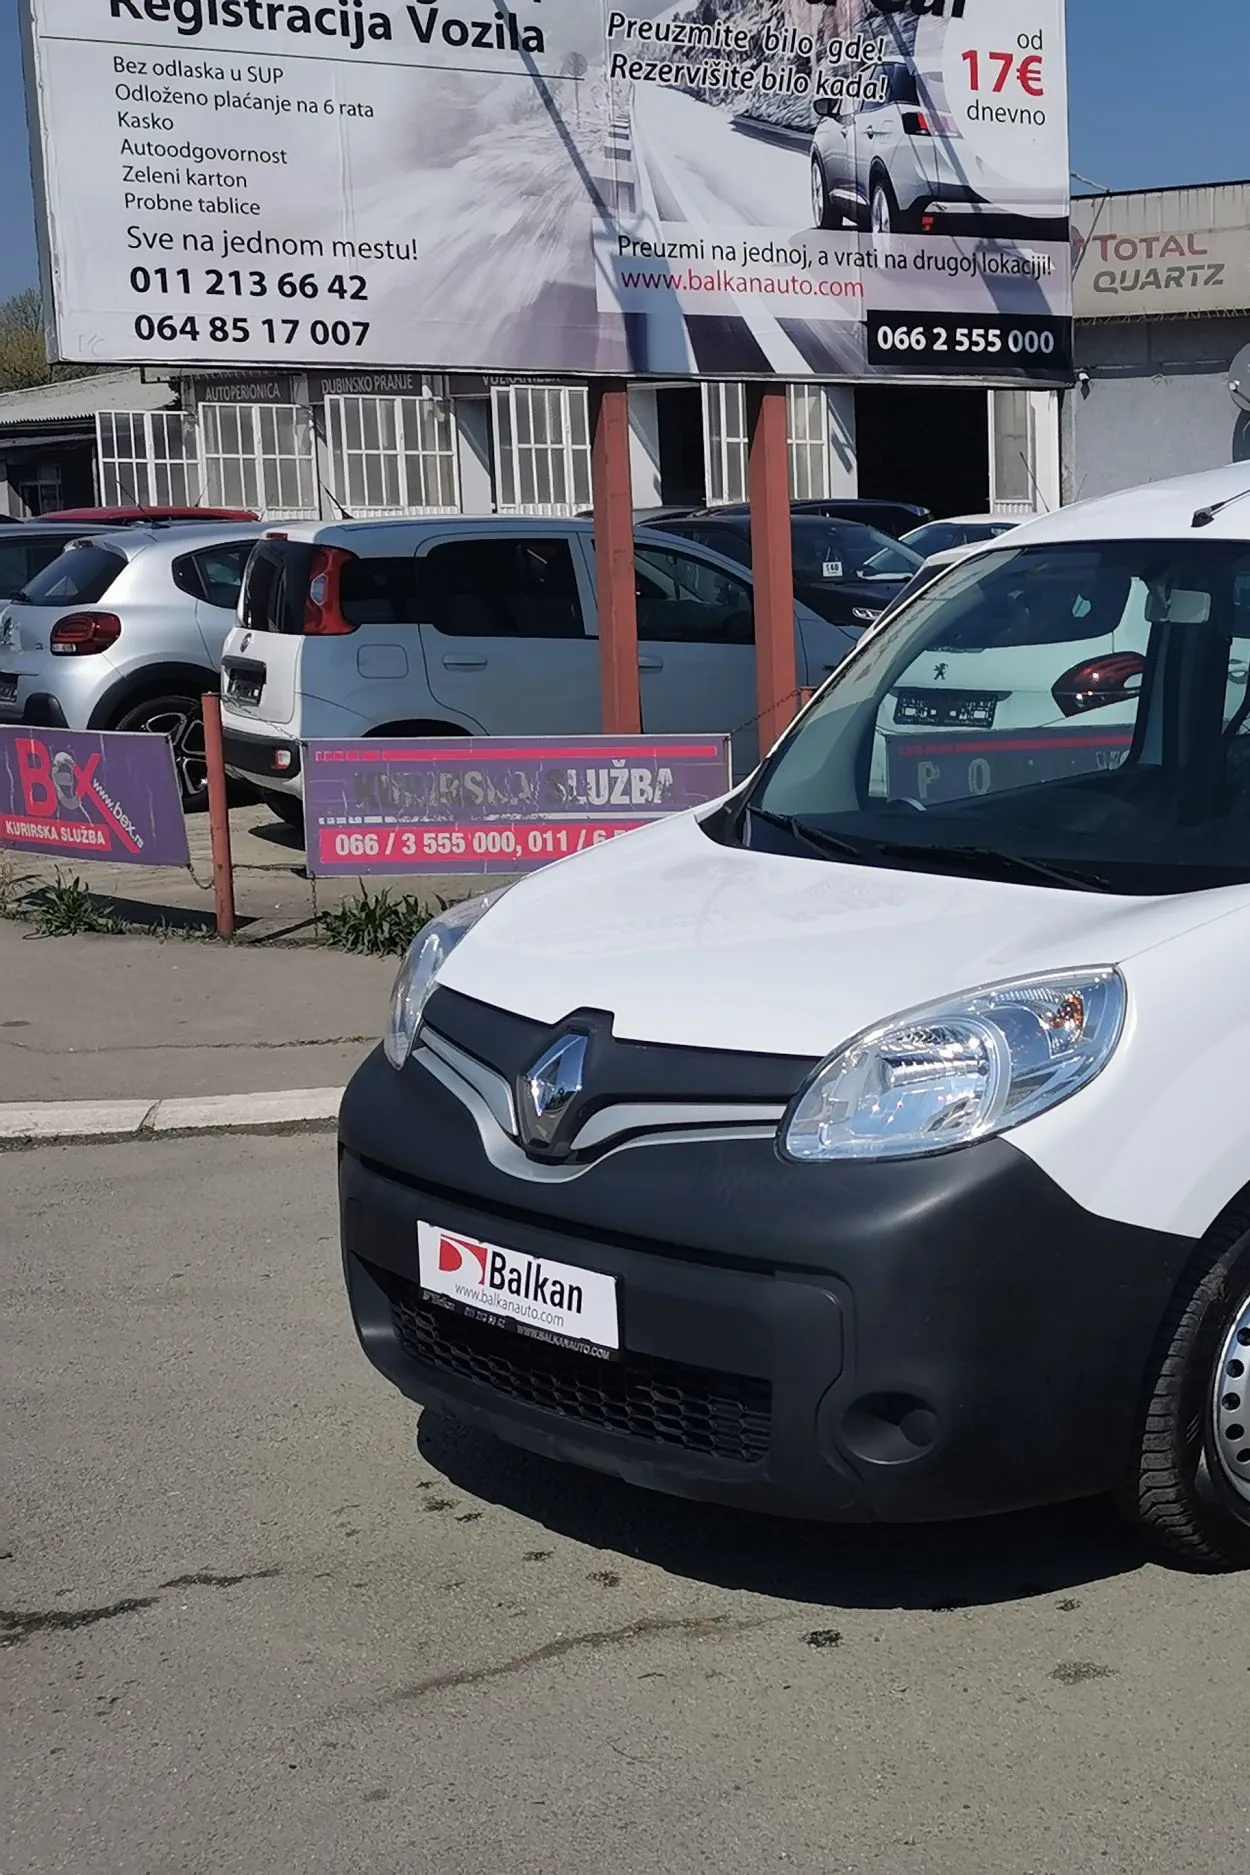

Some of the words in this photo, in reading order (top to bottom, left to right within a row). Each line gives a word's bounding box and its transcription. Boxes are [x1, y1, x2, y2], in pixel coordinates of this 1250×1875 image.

[407, 6, 545, 53] Vozila
[607, 12, 749, 49] Preuzmite
[765, 26, 813, 54] bilo
[829, 35, 885, 64] gde!
[1017, 30, 1043, 50] od
[113, 56, 147, 75] Bez
[153, 60, 225, 80] odlaska
[230, 69, 242, 82] u
[247, 66, 284, 84] SUP
[610, 53, 754, 90] Rezervišite
[761, 65, 809, 93] bilo
[815, 72, 887, 100] kada!
[961, 50, 1044, 97] 17€
[115, 84, 208, 106] Odloženo
[214, 91, 291, 115] plaćanje
[297, 101, 319, 114] na
[323, 100, 335, 115] 6
[339, 102, 374, 118] rata
[967, 99, 1046, 126] dnevno
[118, 111, 174, 131] Kasko
[120, 139, 288, 164] Autoodgovornost
[122, 165, 180, 185] Zeleni
[187, 168, 248, 188] karton
[124, 192, 193, 213] Probne
[198, 196, 261, 215] tablice
[127, 225, 174, 250] Sve
[183, 233, 214, 252] na
[221, 230, 323, 258] jednom
[333, 239, 418, 261] mestu!
[1091, 232, 1208, 262] TOTAL
[618, 235, 704, 260] Preuzmi
[712, 244, 736, 262] na
[741, 240, 813, 270] jednoj,
[818, 250, 829, 266] a
[834, 249, 878, 268] vrati
[885, 252, 907, 270] na
[913, 249, 977, 277] drugoj
[982, 252, 1052, 281] lokaciji!
[130, 266, 191, 294] 011
[205, 269, 267, 297] 213
[278, 272, 319, 299] 66
[328, 274, 369, 301] 42
[621, 268, 864, 297] www.balkanauto.com
[1093, 263, 1225, 295] QUARTZ
[134, 314, 200, 342] 064
[209, 317, 250, 343] 85
[261, 318, 300, 344] 17
[310, 320, 370, 346] 007
[877, 325, 927, 351] 066
[932, 326, 948, 351] 2
[955, 328, 1002, 352] 555
[1008, 329, 1055, 354] 000
[205, 383, 281, 401] AUTOPERIONICA
[321, 376, 373, 394] DUBINSKO
[373, 374, 414, 391] PRANJE
[5, 820, 59, 841] KURIRSKA
[61, 826, 106, 845] SLUŽBA
[335, 833, 378, 856] 066
[385, 832, 396, 856] /
[401, 832, 417, 856] 3
[423, 831, 466, 855] 555
[472, 830, 523, 857] 000,
[527, 830, 568, 852] 011
[489, 1250, 583, 1315] Balkan
[454, 1282, 565, 1328] www.balkanauto.com
